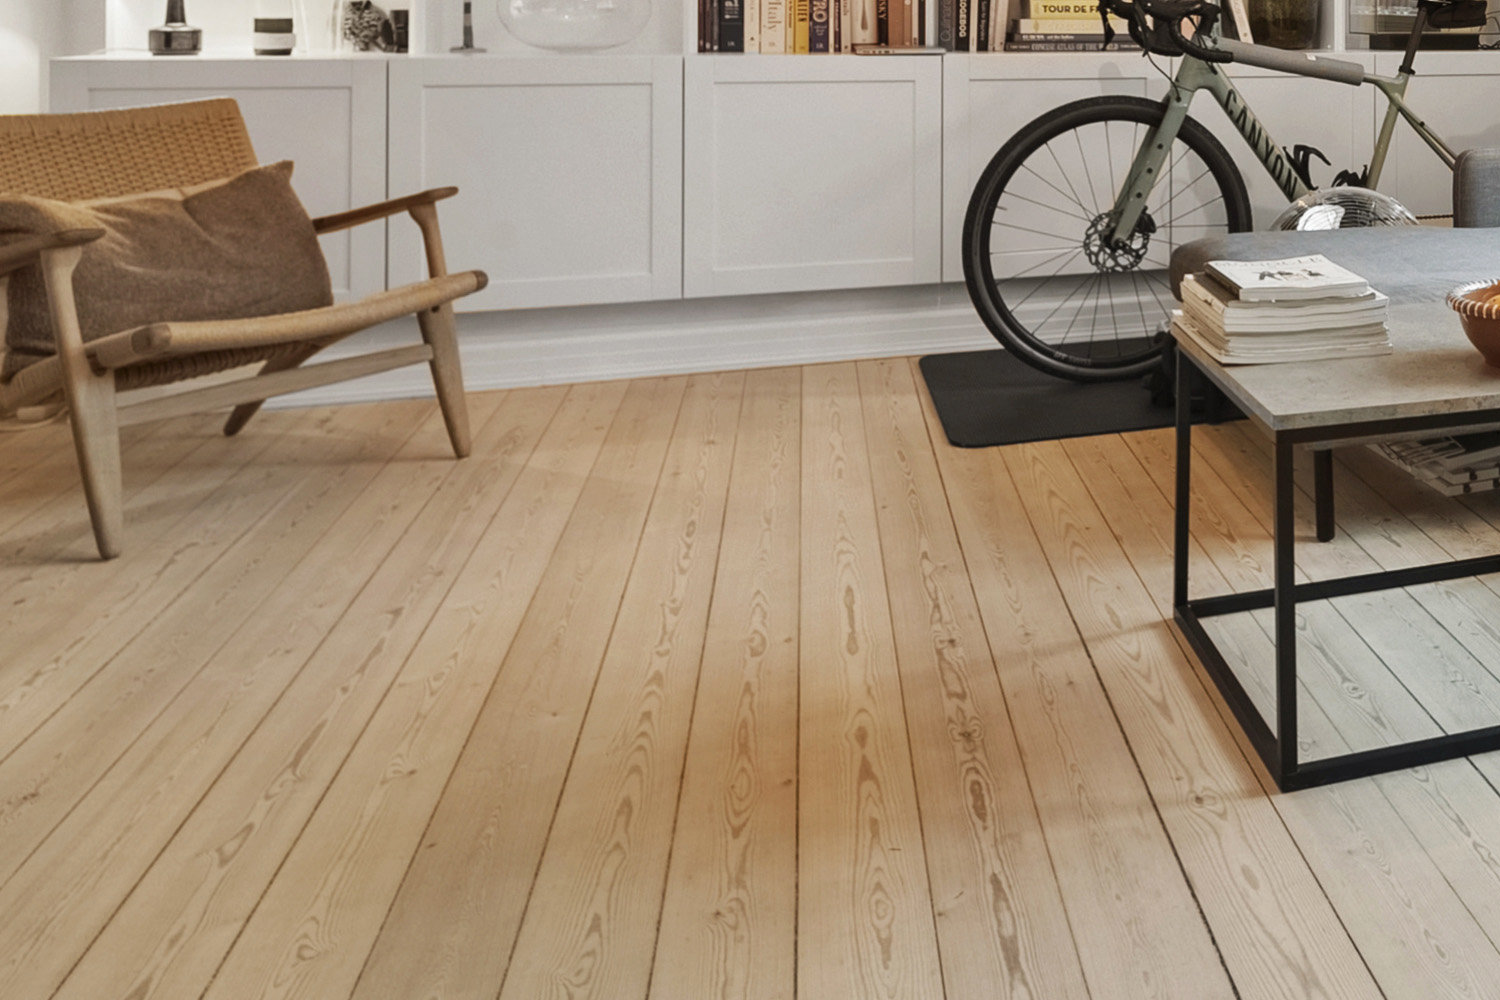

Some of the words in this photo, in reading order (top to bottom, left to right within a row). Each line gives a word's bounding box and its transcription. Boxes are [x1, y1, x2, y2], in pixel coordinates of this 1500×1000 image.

[763, 2, 782, 32] Italy
[1042, 5, 1071, 13] TOUR
[1225, 88, 1297, 202] CANYON
